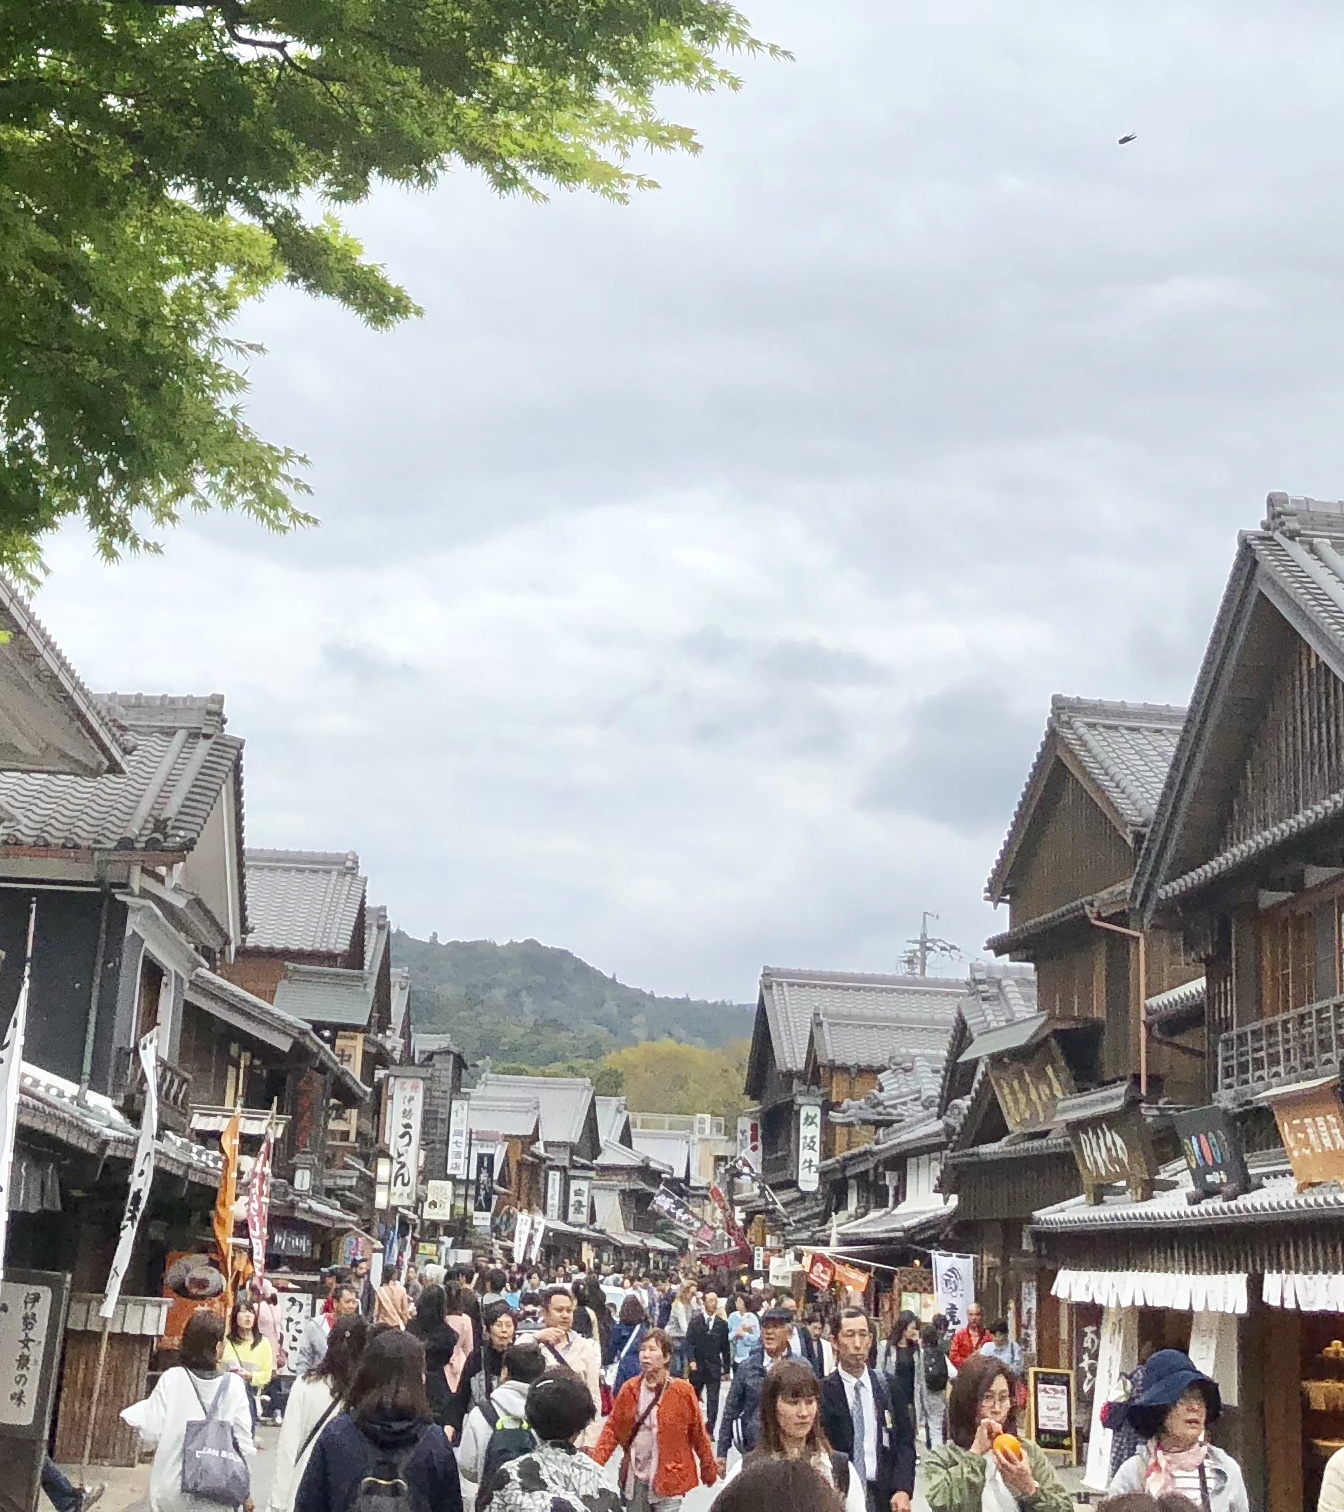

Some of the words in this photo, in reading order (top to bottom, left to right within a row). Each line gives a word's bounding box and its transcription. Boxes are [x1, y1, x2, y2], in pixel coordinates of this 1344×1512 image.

[393, 1095, 415, 1188] 伊勢うどん
[802, 1111, 819, 1175] 松阪牛
